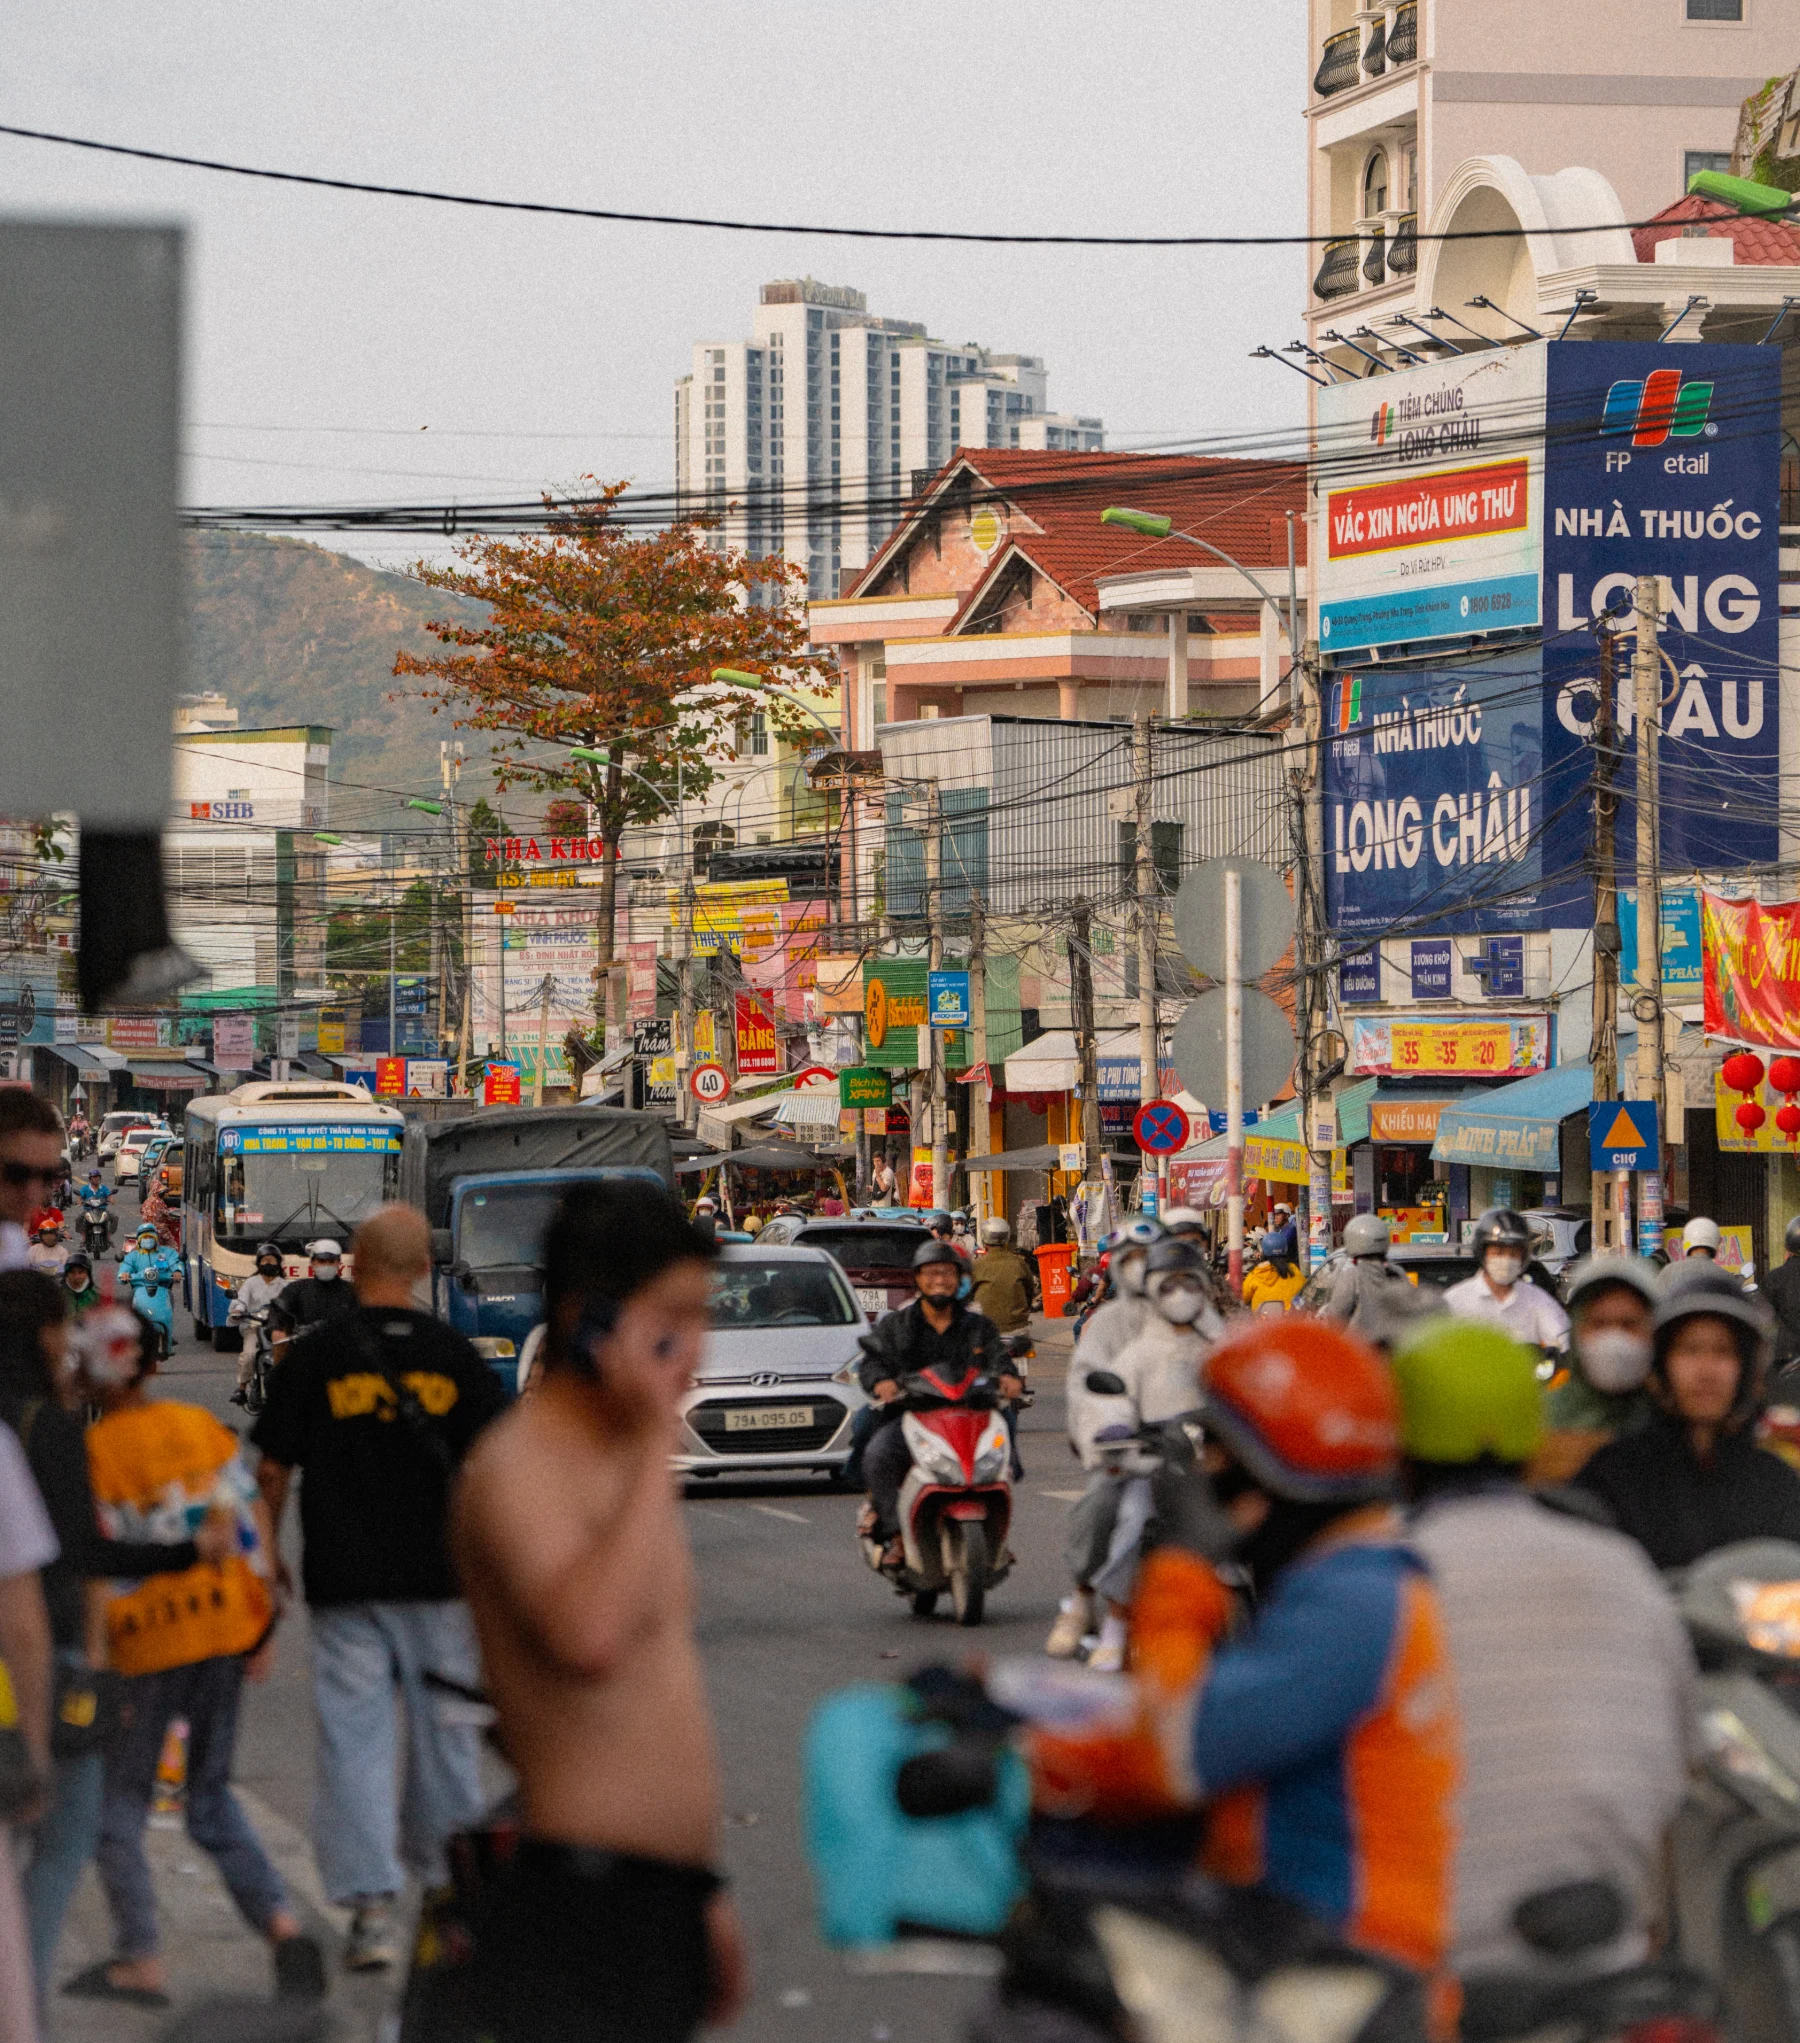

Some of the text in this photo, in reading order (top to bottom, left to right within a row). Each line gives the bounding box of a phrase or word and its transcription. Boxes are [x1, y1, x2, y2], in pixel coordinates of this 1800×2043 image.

[1399, 411, 1480, 462] LONG CHÂU
[1334, 479, 1518, 545] VẮC XIN NGỪA UNG THƯ
[1555, 498, 1762, 540] NHÀ THUỐC
[1558, 572, 1761, 634] LONG
[1373, 683, 1482, 755] NHÀ THUỐC
[212, 802, 254, 819] SHB
[1335, 771, 1530, 874] LONG CHÂU
[485, 837, 543, 861] NHA
[738, 1021, 775, 1051] BẰNG
[702, 1074, 719, 1093] 40
[849, 1088, 887, 1100] XANH
[258, 1127, 278, 1136] CÔNG
[278, 1127, 287, 1135] TY
[306, 1126, 328, 1136] QUYẾT
[329, 1126, 351, 1135] THẮNG
[367, 1127, 389, 1136] TRANG
[1380, 1107, 1437, 1136] KHIẾU NẠI
[223, 1134, 238, 1148] 101
[243, 1138, 261, 1150] NHA
[262, 1137, 288, 1150] TRANG
[372, 1137, 386, 1150] TUY
[1612, 1151, 1638, 1167] CHỢ
[862, 1290, 880, 1301] 79A
